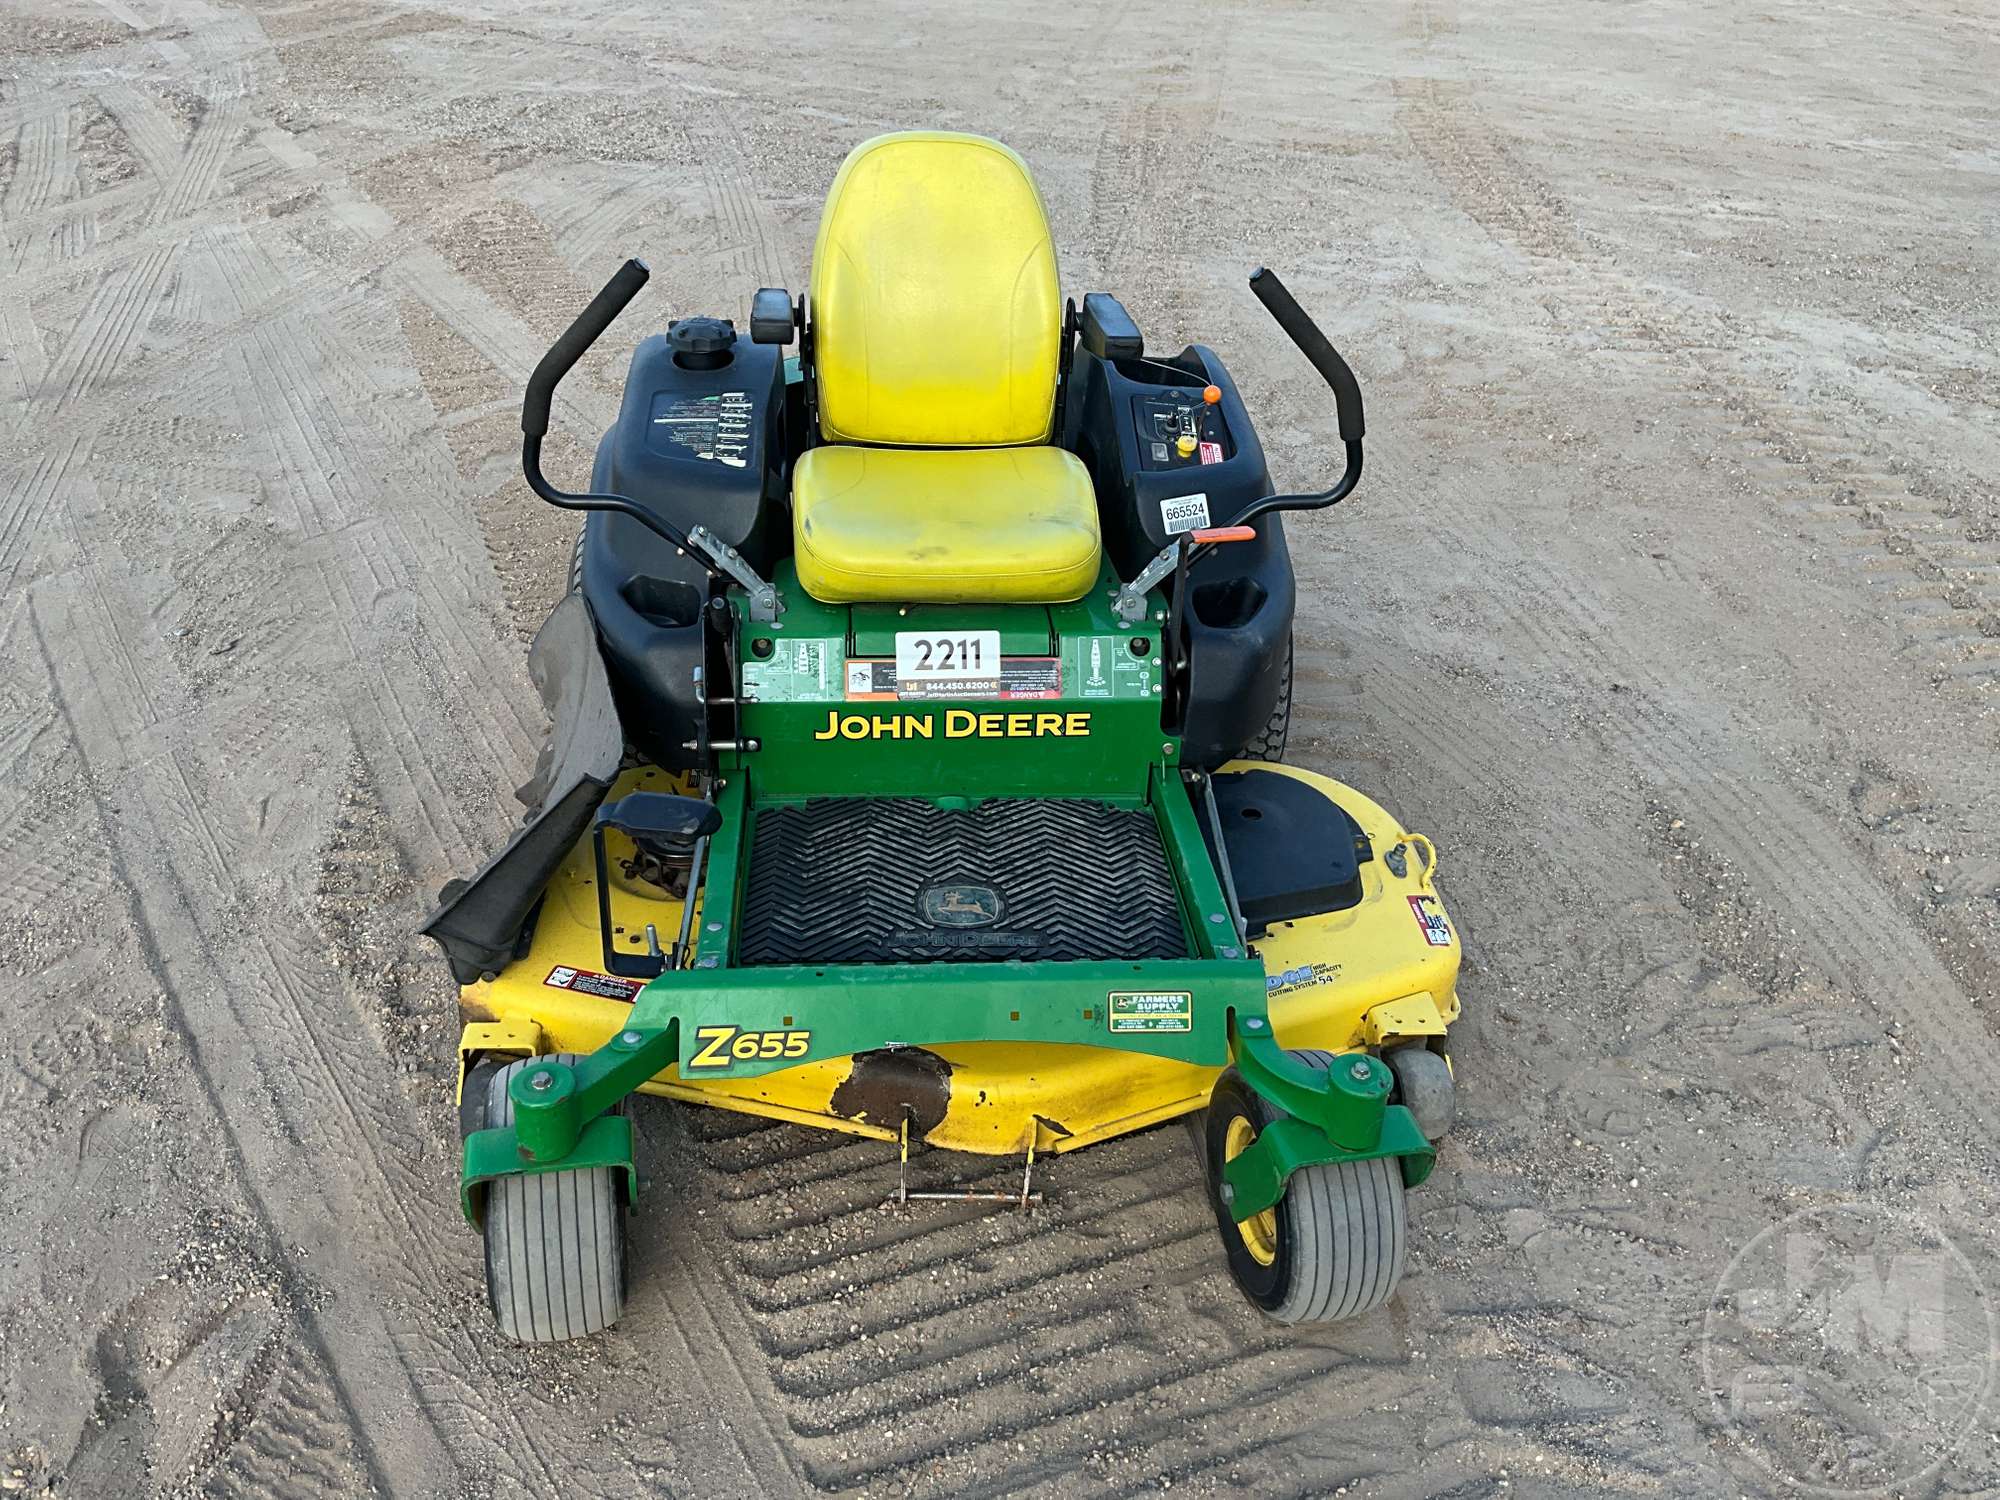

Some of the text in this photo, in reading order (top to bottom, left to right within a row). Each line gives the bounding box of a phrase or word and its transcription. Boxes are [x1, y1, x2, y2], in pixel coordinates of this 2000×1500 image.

[1166, 502, 1205, 520] 665524
[914, 638, 981, 671] 2211
[926, 681, 989, 691] 844.450.6200
[1268, 986, 1294, 998] CUTTING
[1294, 980, 1318, 991] SYSTEM
[1132, 995, 1184, 1003] FARMERS
[689, 1026, 810, 1067] Z655
